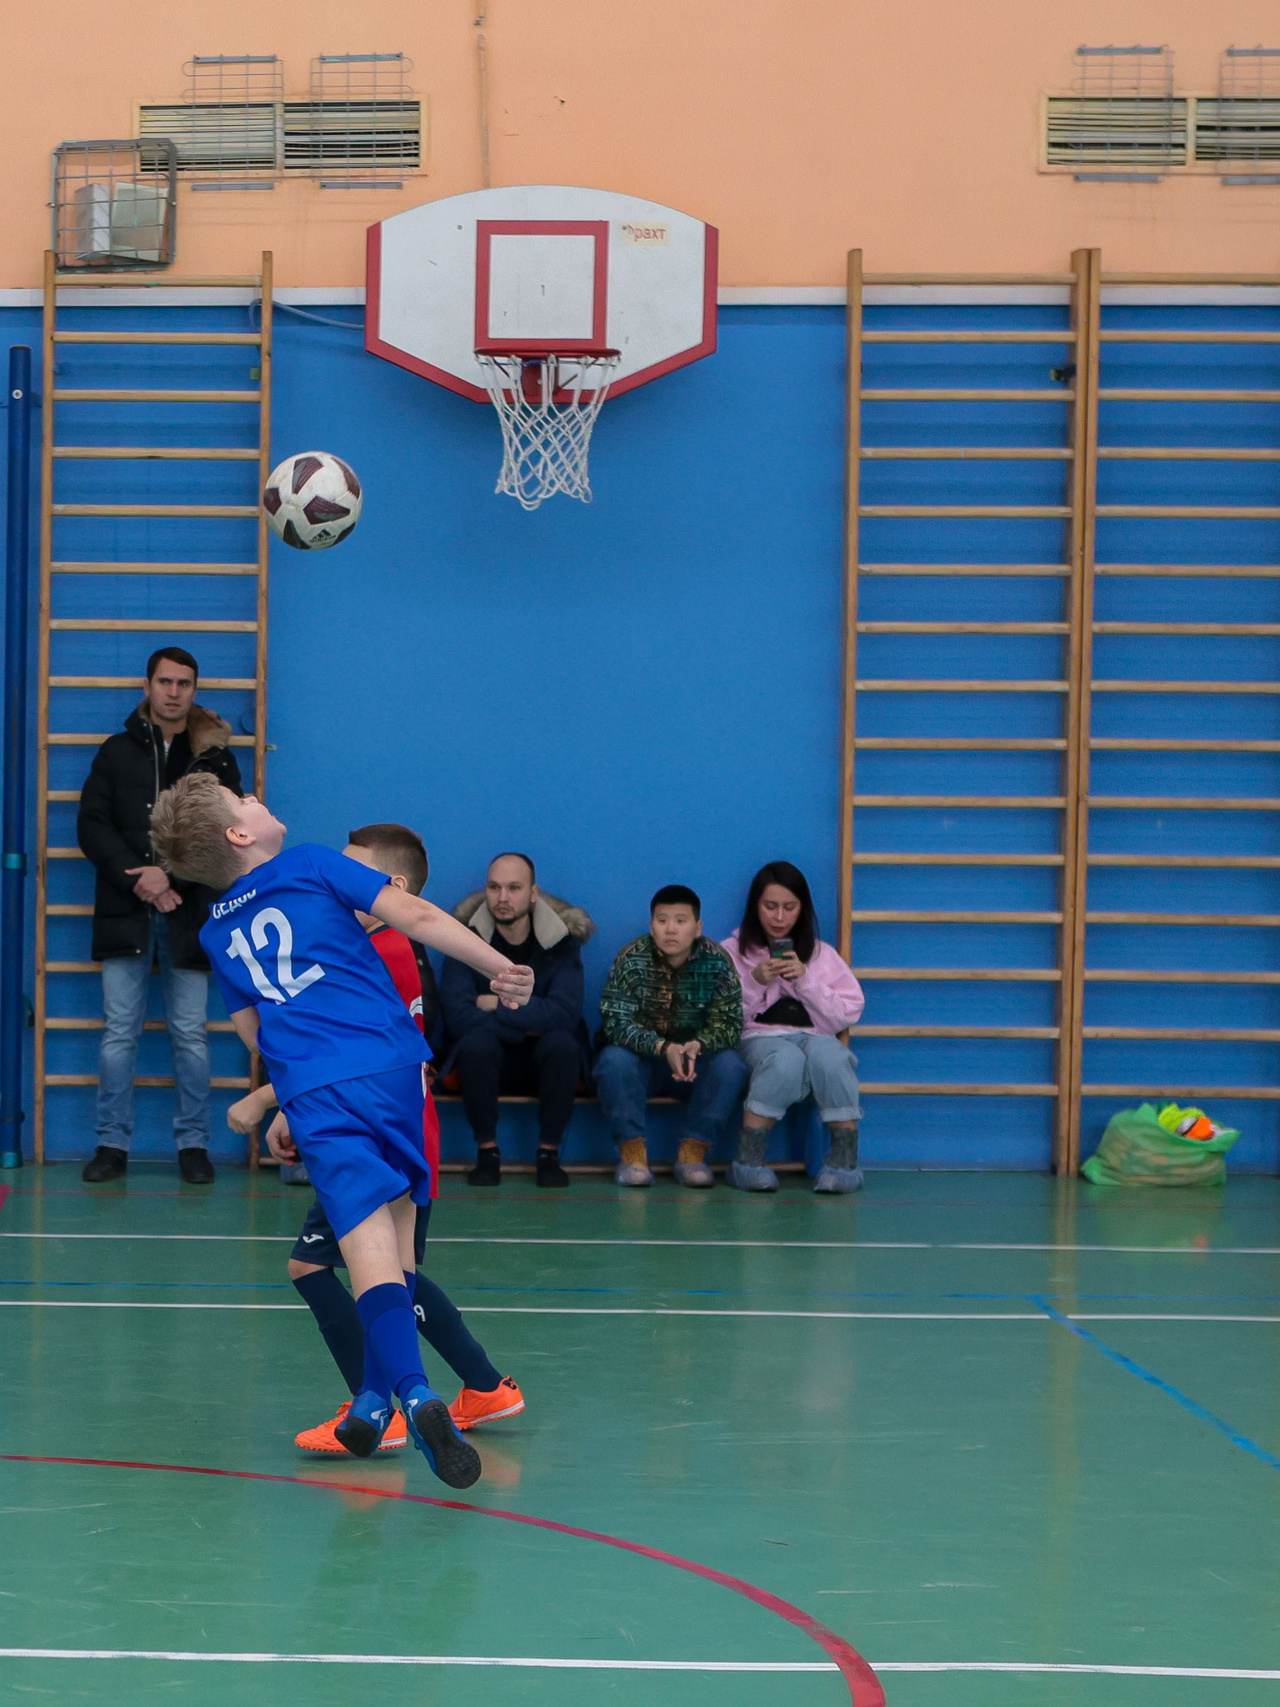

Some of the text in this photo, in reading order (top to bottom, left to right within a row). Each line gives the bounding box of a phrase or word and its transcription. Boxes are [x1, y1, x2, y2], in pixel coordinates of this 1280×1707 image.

[627, 224, 667, 242] рахт
[225, 907, 326, 1005] 12
[413, 1304, 426, 1322] 9
